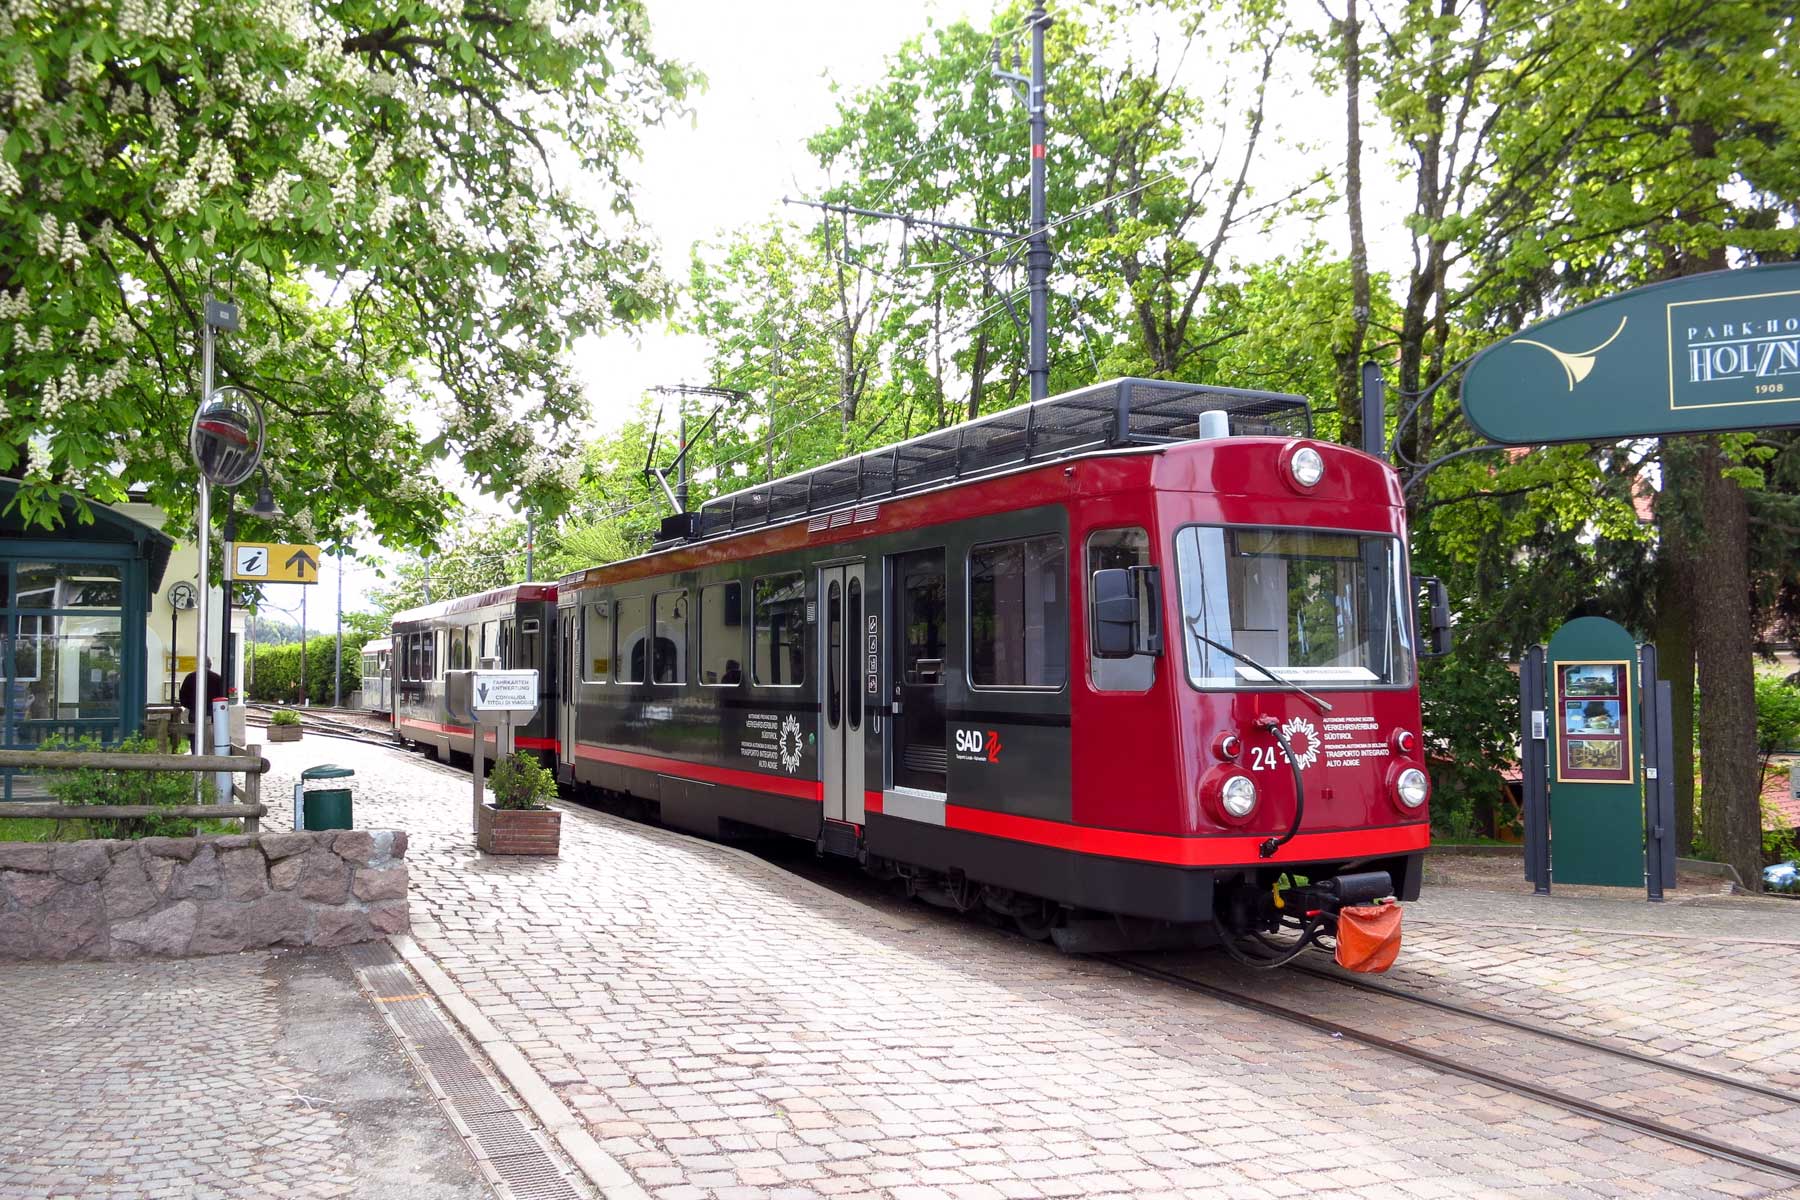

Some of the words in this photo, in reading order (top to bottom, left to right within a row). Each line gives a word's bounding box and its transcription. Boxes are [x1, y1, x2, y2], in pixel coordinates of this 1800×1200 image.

[1688, 340, 1800, 382] HOLZN
[1755, 383, 1784, 394] 1908
[1323, 723, 1379, 731] VERKEHRSVERBUND
[956, 729, 983, 752] SAD
[1324, 732, 1352, 740] SÜDTIROL
[1251, 746, 1277, 771] 24
[1326, 750, 1360, 758] TRASPORTO
[1361, 749, 1390, 757] INTEGRATO
[1342, 759, 1360, 767] ADIGE
